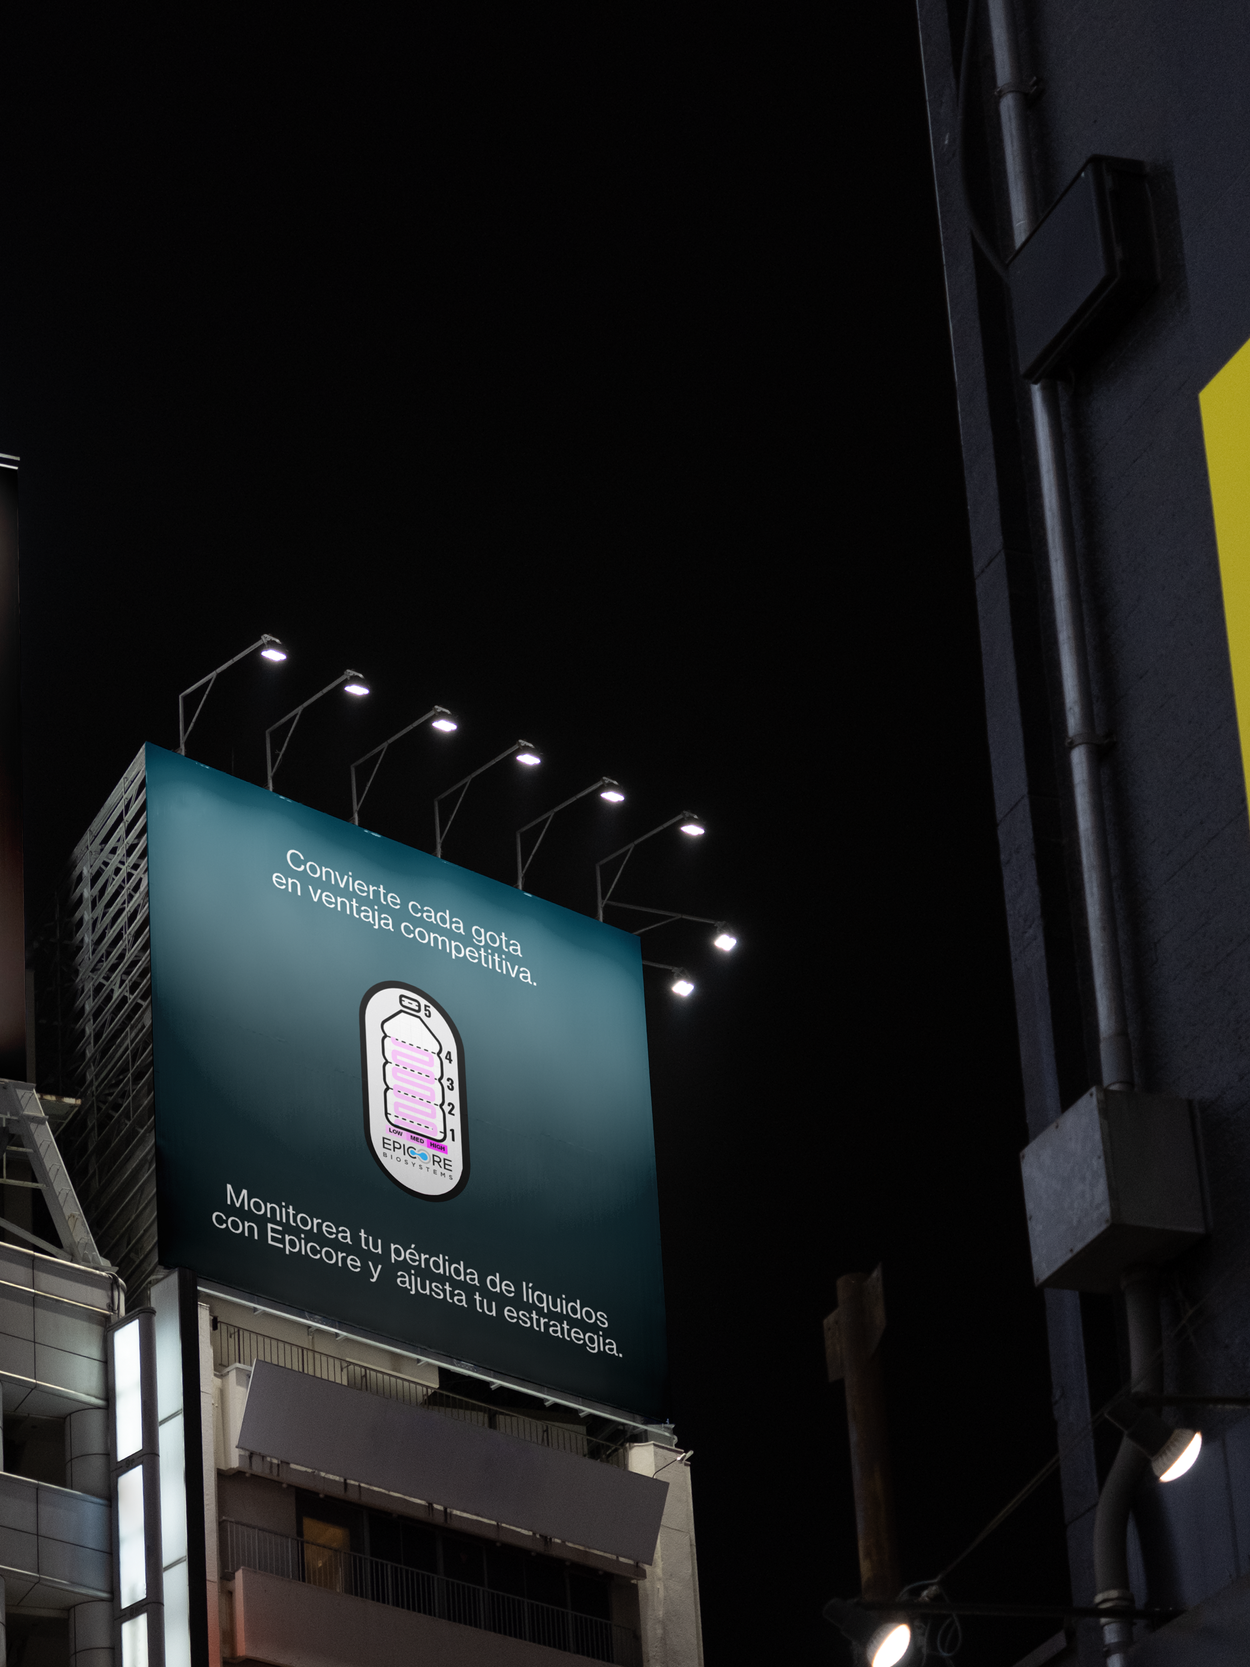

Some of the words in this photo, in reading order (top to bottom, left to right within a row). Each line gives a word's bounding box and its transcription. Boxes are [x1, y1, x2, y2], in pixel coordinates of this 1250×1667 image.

[286, 849, 401, 909] Convierte
[408, 897, 465, 935] cada
[472, 926, 523, 957] gota
[272, 870, 301, 896] en
[308, 884, 394, 932] ventaja
[400, 920, 538, 986] competitiva.
[424, 1005, 431, 1018] 5
[444, 1051, 453, 1064] 4
[446, 1077, 455, 1091] 3
[447, 1102, 455, 1116] 2
[388, 1128, 403, 1137] LOW
[409, 1134, 425, 1144] MED
[429, 1141, 446, 1152] HIGH
[450, 1129, 456, 1142] 1
[382, 1151, 453, 1181] BIOSYSTEMS
[226, 1183, 352, 1245] Monitorea
[359, 1228, 383, 1255] tu
[390, 1242, 480, 1287] pérdida
[487, 1272, 515, 1297] de
[522, 1281, 608, 1328] líquidos
[212, 1209, 259, 1239] con
[267, 1230, 361, 1273] Epicore
[368, 1260, 382, 1282] y
[396, 1269, 468, 1307] ajusta
[474, 1290, 498, 1317] tu
[504, 1304, 623, 1358] estrategia.
